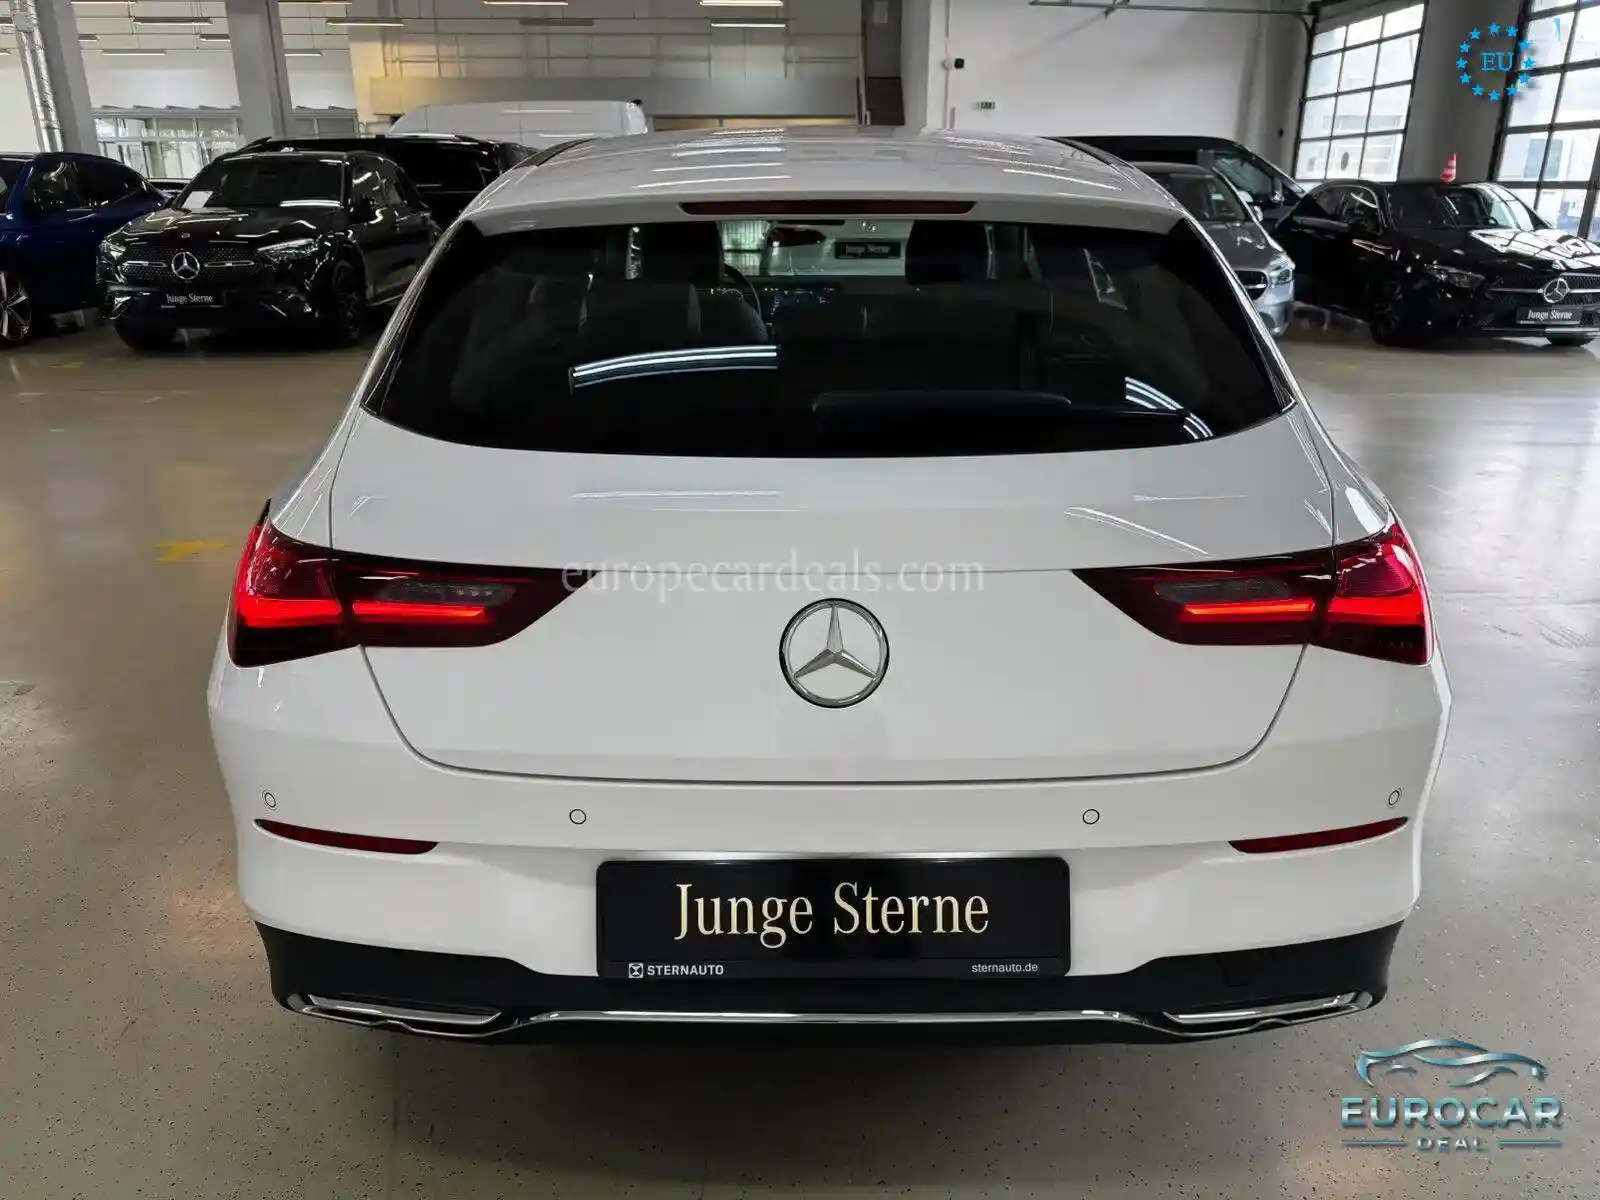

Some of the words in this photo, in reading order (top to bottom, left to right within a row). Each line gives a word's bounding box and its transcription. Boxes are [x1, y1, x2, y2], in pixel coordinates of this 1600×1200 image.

[674, 883, 814, 949] Junge
[833, 881, 990, 935] Sterne
[646, 964, 725, 977] STERNAUTO
[971, 962, 1039, 974] sternauto.de
